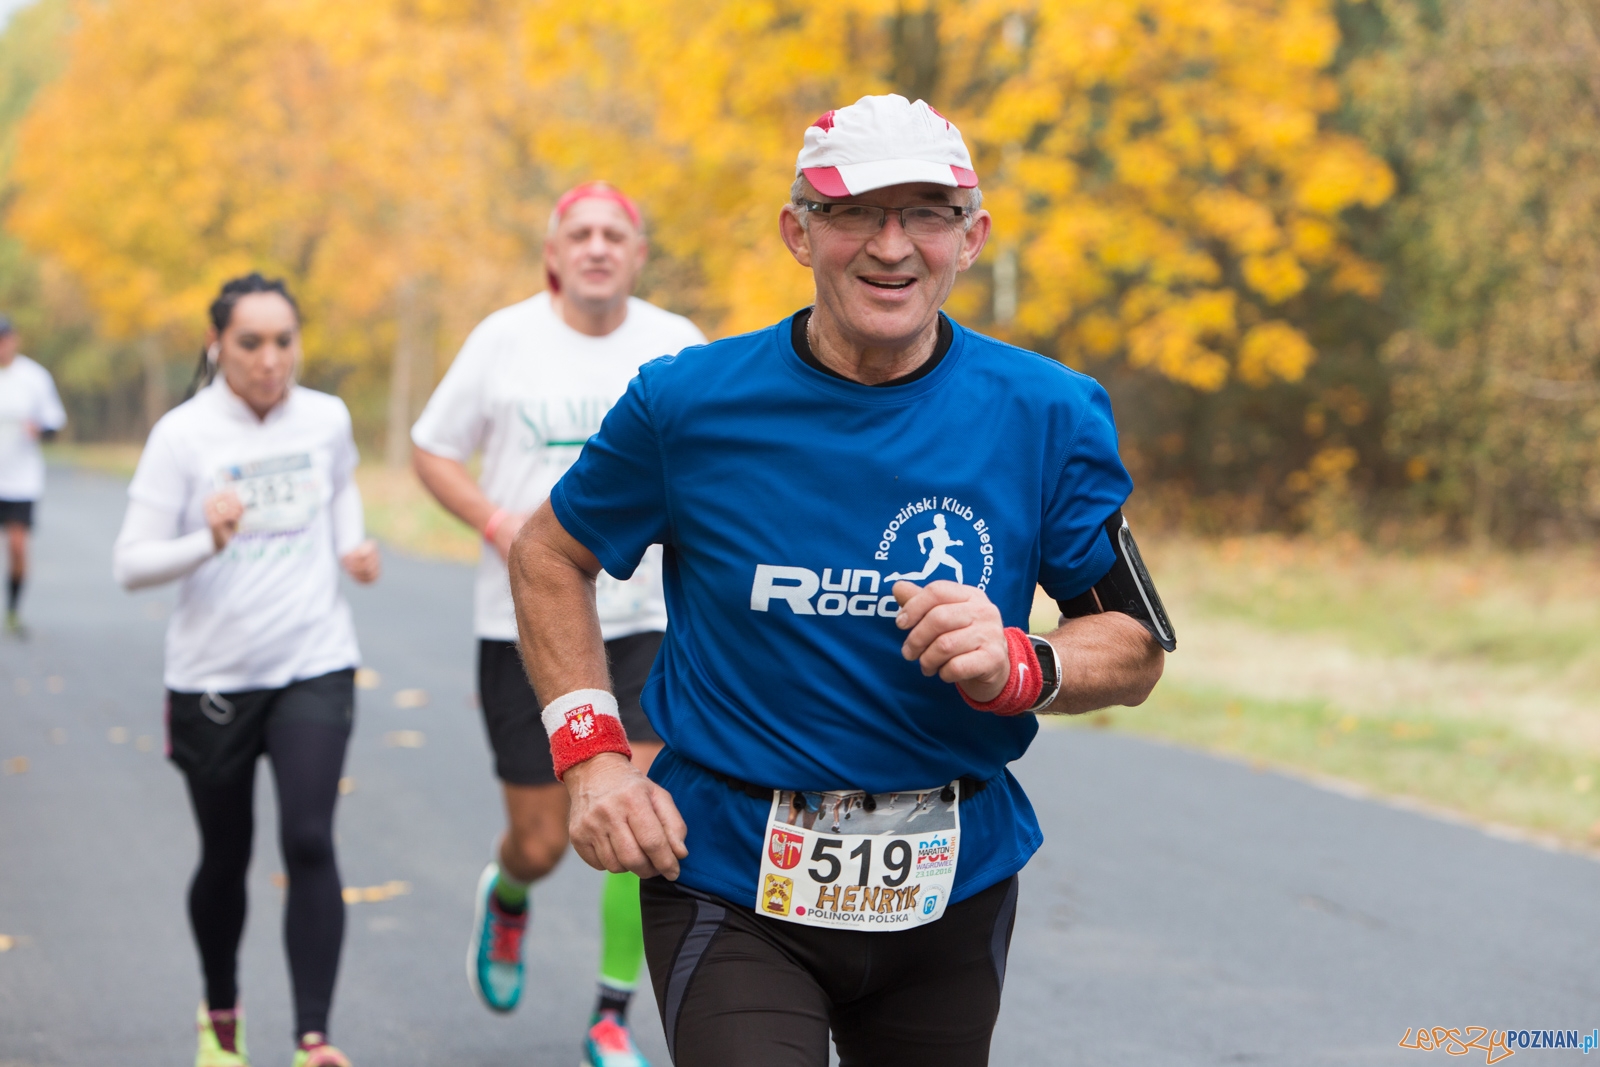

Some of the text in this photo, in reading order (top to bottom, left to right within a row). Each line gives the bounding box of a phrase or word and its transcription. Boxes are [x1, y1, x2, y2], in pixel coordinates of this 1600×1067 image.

[875, 496, 937, 560] Rogoziński
[941, 496, 973, 521] Klub
[808, 838, 912, 887] 519
[918, 846, 950, 857] MARATON
[915, 867, 953, 878] 23.10.2016
[816, 885, 921, 914] HENRYK
[807, 908, 865, 922] POLINOVA
[868, 914, 908, 923] POLSKA
